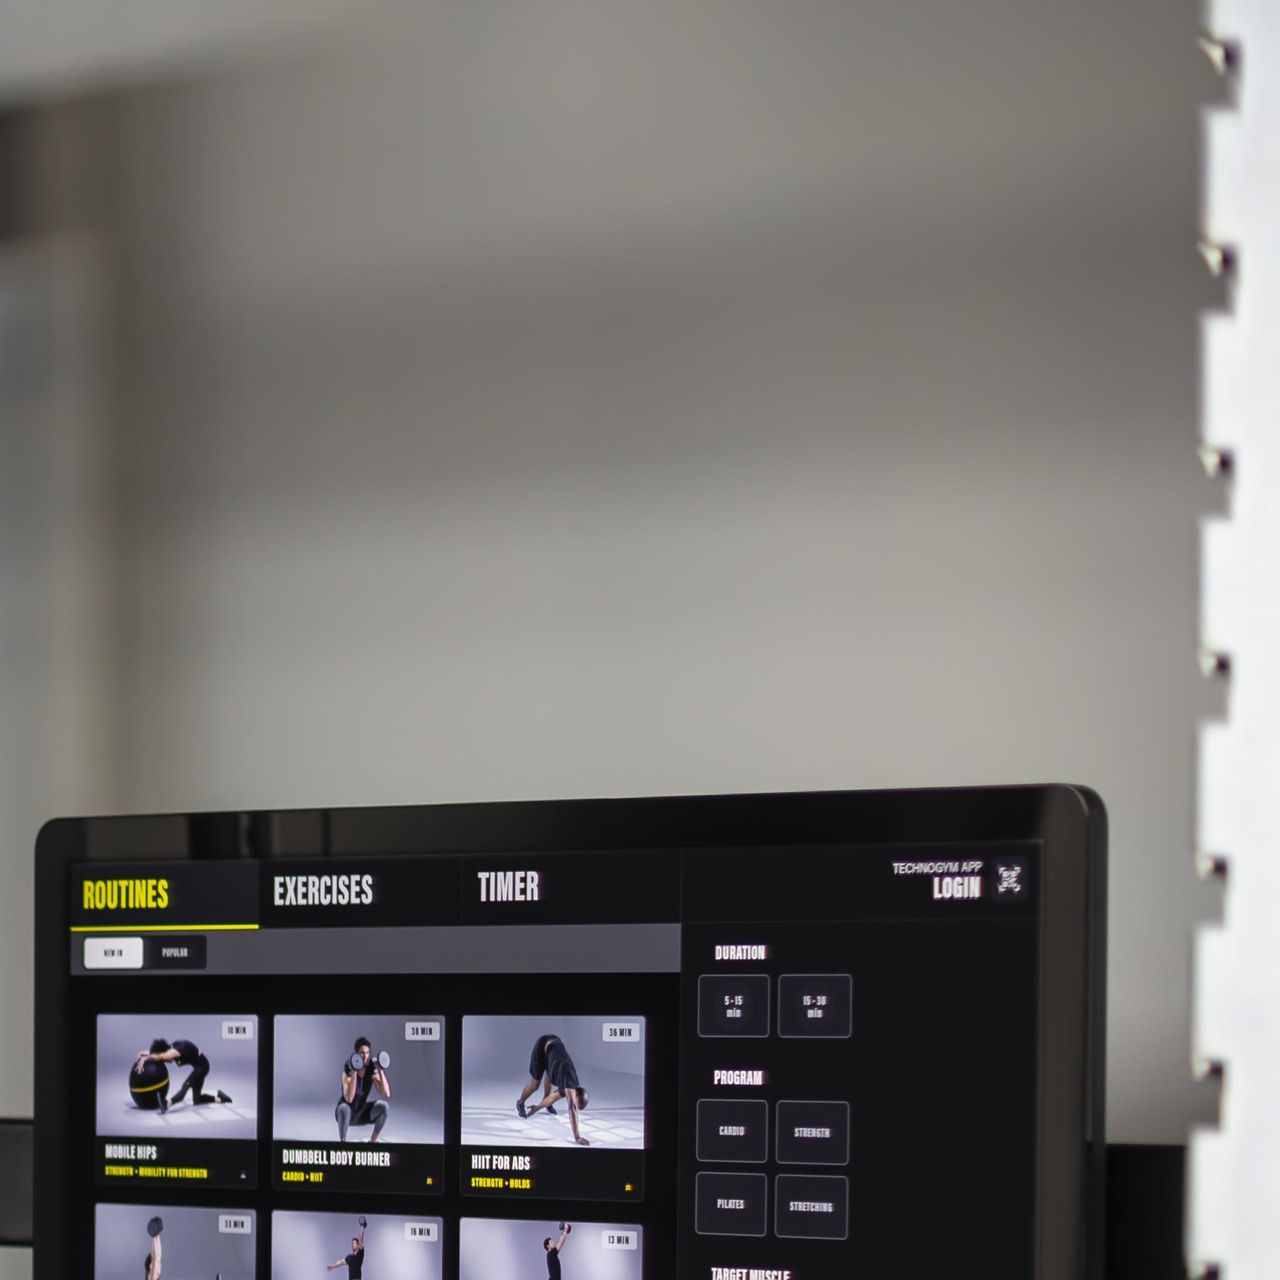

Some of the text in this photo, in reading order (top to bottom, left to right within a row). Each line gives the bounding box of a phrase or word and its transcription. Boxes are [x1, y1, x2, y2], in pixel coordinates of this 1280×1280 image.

[892, 861, 983, 875] TECHNOGYM APP
[274, 874, 373, 907] EXERCISES
[477, 870, 540, 902] TIMER
[933, 876, 981, 899] LOGIN
[83, 879, 169, 910] ROUTINES
[162, 948, 188, 958] POPULAR
[715, 945, 766, 960] DURATION
[235, 1026, 246, 1035] MIN
[420, 1027, 432, 1036] MIN
[609, 1028, 632, 1037] 36 MIN
[714, 1070, 763, 1085] PROGRAM
[719, 1126, 745, 1136] CARDIO
[794, 1127, 831, 1138] STRENGTH
[105, 1144, 157, 1160] MOBILE HIPS
[282, 1149, 390, 1167] DUMBBELL BODY BURNER
[472, 1154, 530, 1171] HIIT FOR ABS
[282, 1171, 305, 1182] CARDIO
[471, 1177, 531, 1189] STRENGTH HOLDS
[717, 1199, 744, 1209] PILATES
[789, 1201, 833, 1212] STRETCHING
[233, 1220, 244, 1229] MIN
[419, 1228, 430, 1236] MIN
[608, 1235, 629, 1245] 13 MIN
